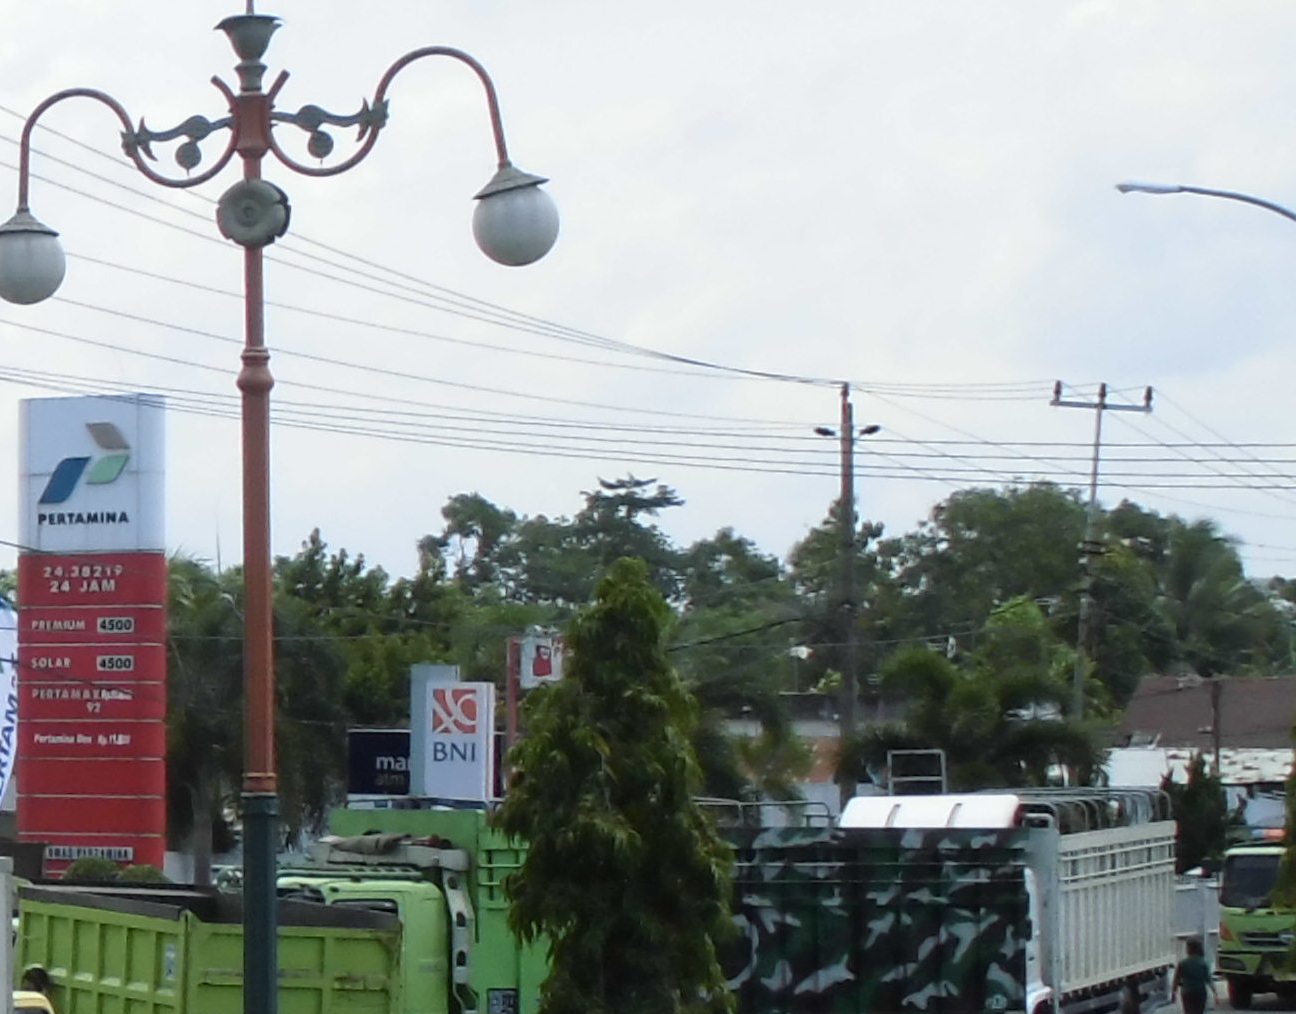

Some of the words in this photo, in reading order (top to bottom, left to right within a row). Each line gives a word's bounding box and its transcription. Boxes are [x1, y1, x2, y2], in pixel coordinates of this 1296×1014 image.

[37, 512, 130, 526] PERTAMINA
[49, 579, 70, 593] 24
[79, 579, 116, 593] JAM
[31, 620, 86, 630] PREMIUM
[99, 619, 133, 631] 4500
[31, 657, 71, 669] SOLAR
[99, 657, 132, 669] 4500
[433, 741, 476, 762] BNI
